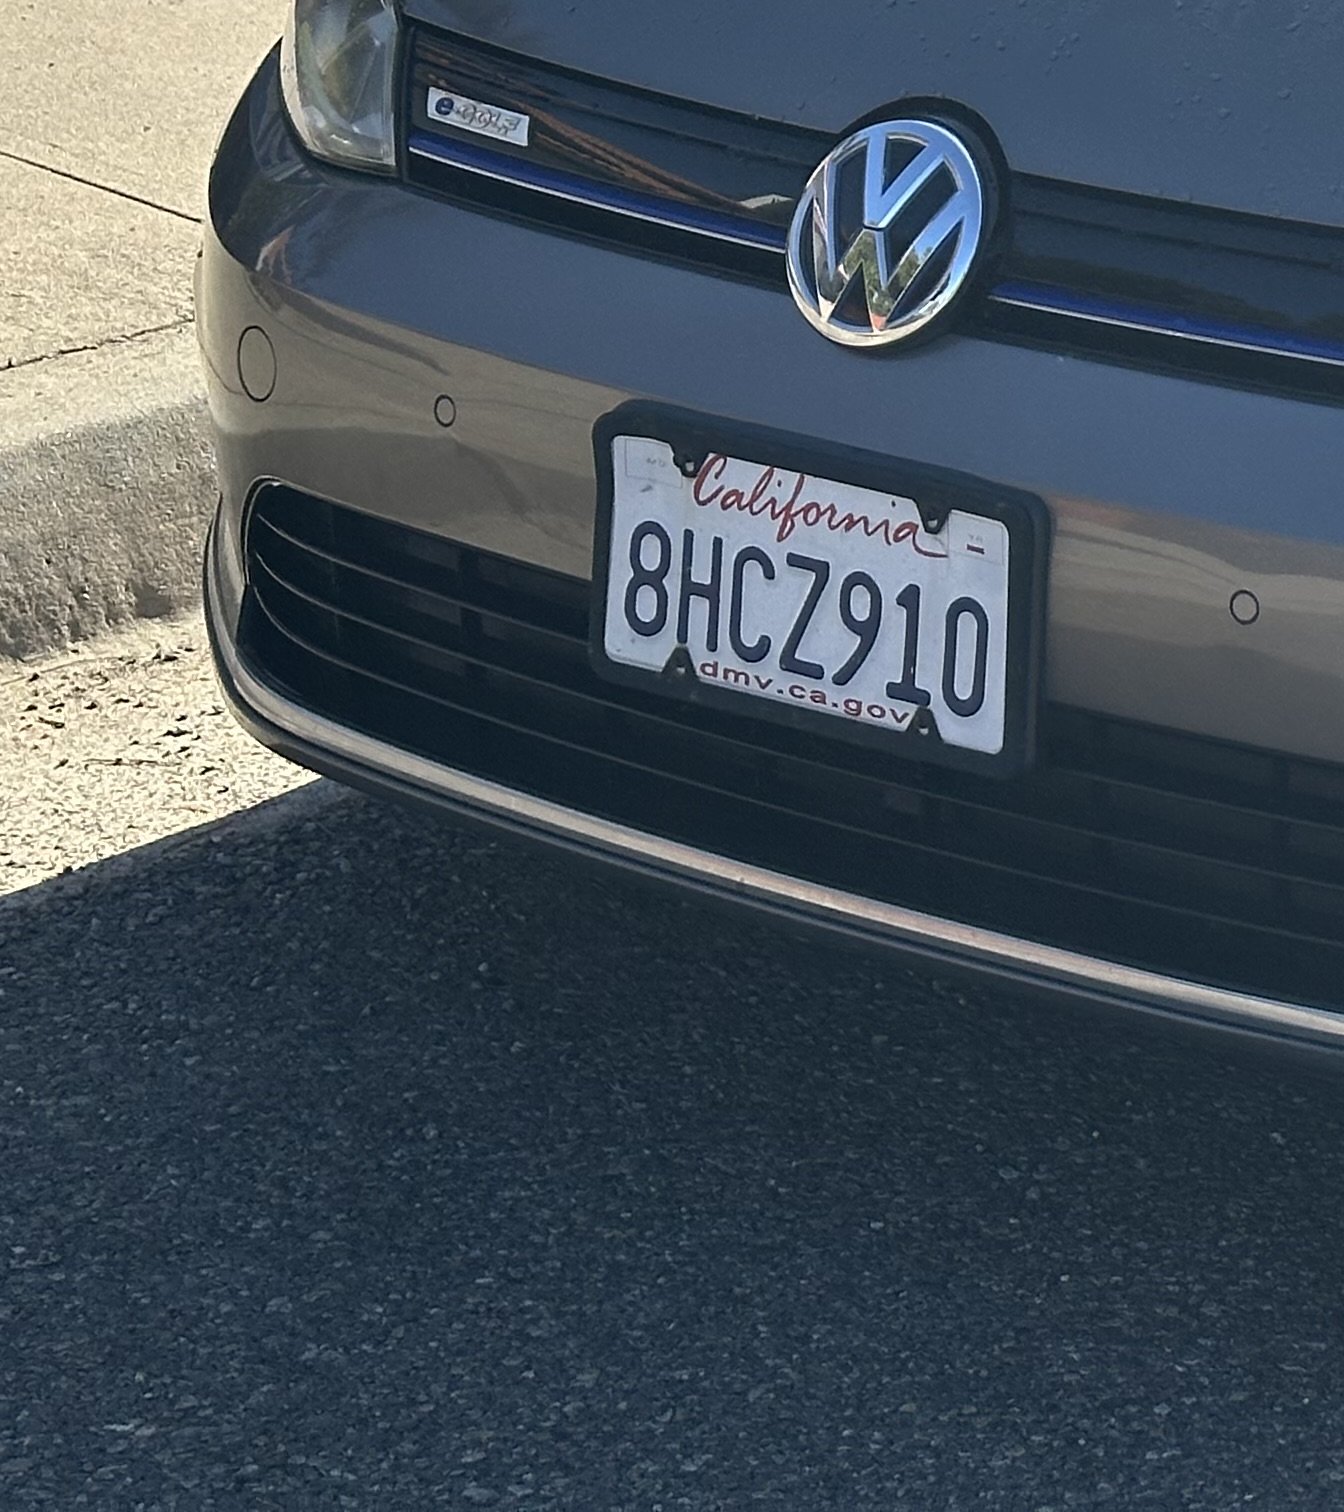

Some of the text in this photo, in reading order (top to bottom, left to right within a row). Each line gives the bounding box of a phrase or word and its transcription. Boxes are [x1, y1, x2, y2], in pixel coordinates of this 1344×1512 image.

[693, 453, 949, 559] California
[625, 520, 990, 717] 8HCZ910
[699, 660, 911, 725] dmv.ca.gov
